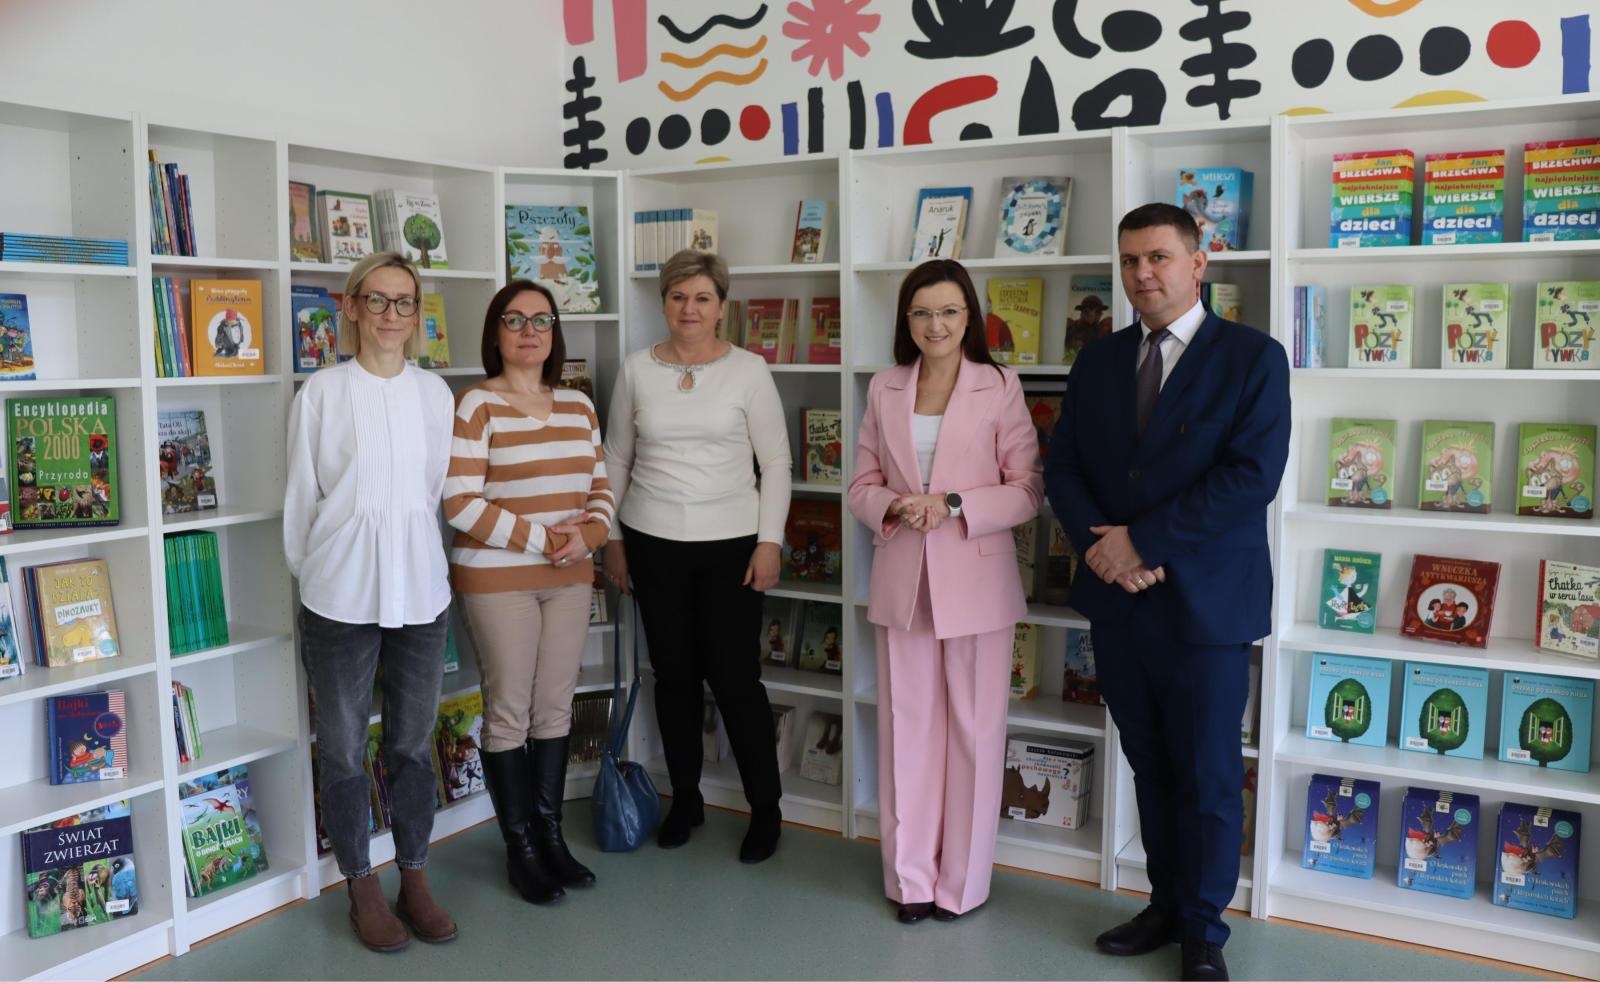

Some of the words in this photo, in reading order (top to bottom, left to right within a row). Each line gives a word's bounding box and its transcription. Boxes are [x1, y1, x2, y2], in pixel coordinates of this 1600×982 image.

[1532, 156, 1600, 170] BRZECHWA
[1339, 167, 1402, 179] BRZECHWA
[1433, 166, 1498, 179] BRZECHWA
[1433, 191, 1497, 205] WIERSZE
[1532, 183, 1600, 199] WIERSZE
[1339, 192, 1400, 206] WIERSZE
[1558, 200, 1579, 210] dla
[1361, 207, 1381, 218] dla
[1455, 205, 1476, 216] dla
[1533, 210, 1597, 226] dzieci
[518, 209, 577, 230] Pszczoły
[1339, 218, 1396, 232] dzieci
[1432, 216, 1492, 231] dzieci
[14, 401, 108, 418] Encyklopedia
[16, 416, 110, 438] POLSKA
[43, 435, 81, 460] 2000
[39, 467, 89, 482] Przyroda
[1431, 563, 1478, 577] WNUCZKA
[1548, 576, 1584, 591] Chatka
[1577, 590, 1594, 602] lasu
[57, 826, 104, 846] ŚWIAT
[191, 816, 243, 849] BAJKI
[43, 838, 120, 864] ZWIERZĄT
